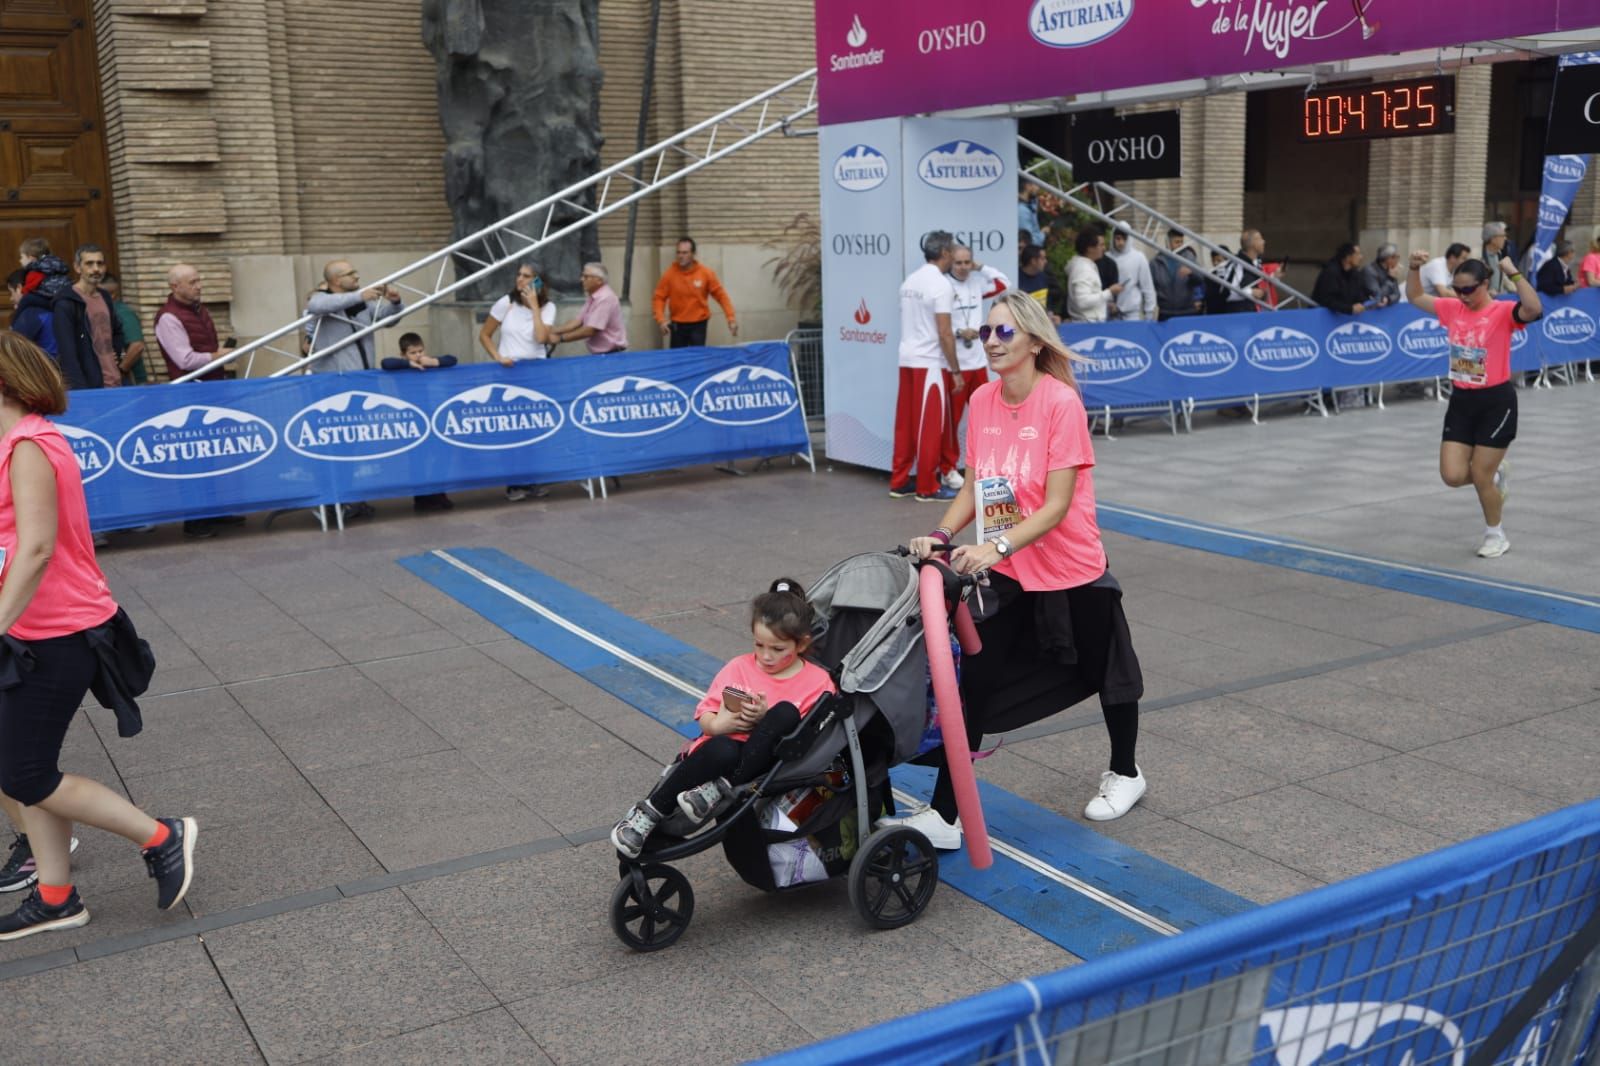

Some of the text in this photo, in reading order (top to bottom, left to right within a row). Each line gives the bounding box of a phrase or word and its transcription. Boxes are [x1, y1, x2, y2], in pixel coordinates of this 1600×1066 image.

[1037, 0, 1124, 33] ASTURIANA
[918, 20, 986, 54] OYSHO
[1211, 0, 1328, 58] de la Mujer
[830, 48, 884, 72] Santander
[1305, 85, 1435, 136] 00:47:25
[1088, 134, 1165, 164] OYSHO
[924, 160, 998, 178] ASTURIANA
[832, 233, 890, 256] OYSHO
[839, 326, 887, 344] Santander
[1332, 338, 1388, 355] ASTURIANA
[1168, 348, 1233, 366] ASTURIANA
[1252, 344, 1314, 361] ASTURIANA
[461, 404, 503, 415] CENTRAL
[581, 399, 682, 424] ASTURIANA
[701, 390, 792, 413] ASTURIANA
[318, 411, 414, 424] CENTRAL LECHERA
[443, 410, 555, 435] ASTURIANA
[153, 424, 259, 441] CENTRAL LECHERA
[297, 420, 420, 447] ASTURIANA
[130, 434, 267, 465] ASTURIANA
